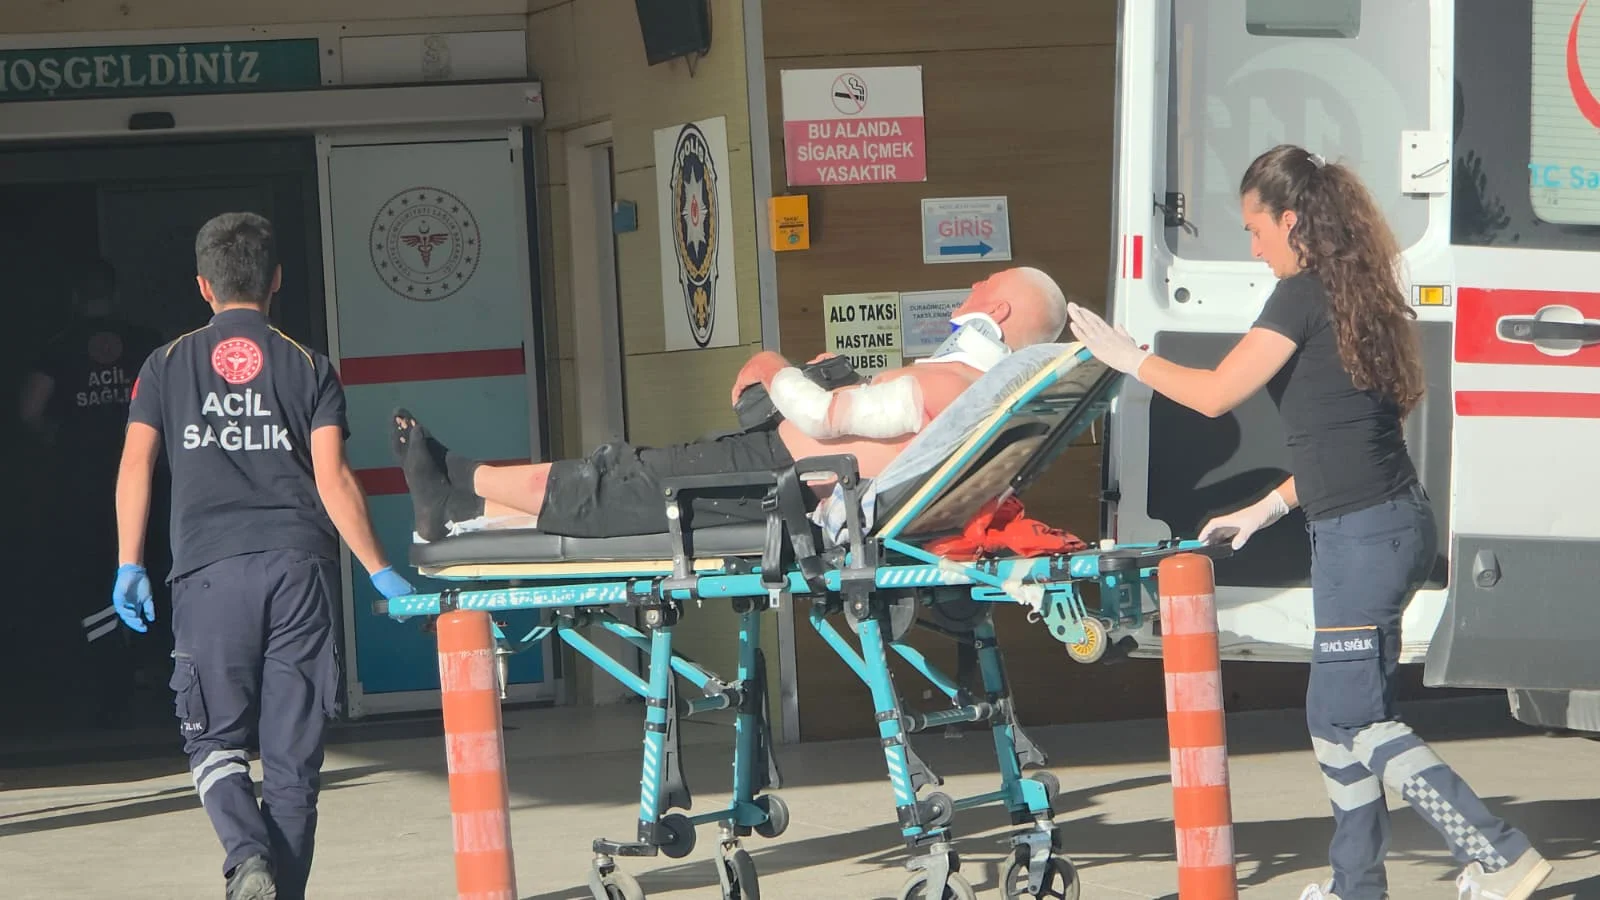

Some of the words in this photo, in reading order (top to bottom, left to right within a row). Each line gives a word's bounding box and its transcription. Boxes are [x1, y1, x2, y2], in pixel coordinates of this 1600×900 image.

[808, 123, 831, 139] BU
[835, 121, 902, 138] ALANDA
[797, 144, 859, 161] SİGARA
[863, 142, 913, 162] İÇMEK
[817, 164, 897, 182] YASAKTIR
[1570, 165, 1600, 190] Sa
[938, 216, 993, 240] GİRİŞ
[830, 305, 855, 323] ALO
[836, 333, 893, 349] HASTANE
[88, 366, 130, 386] ACİL
[76, 386, 132, 407] SAĞLI
[201, 388, 272, 417] ACİL
[183, 421, 293, 452] SAĞLIK
[1344, 637, 1374, 652] SAĞLIK
